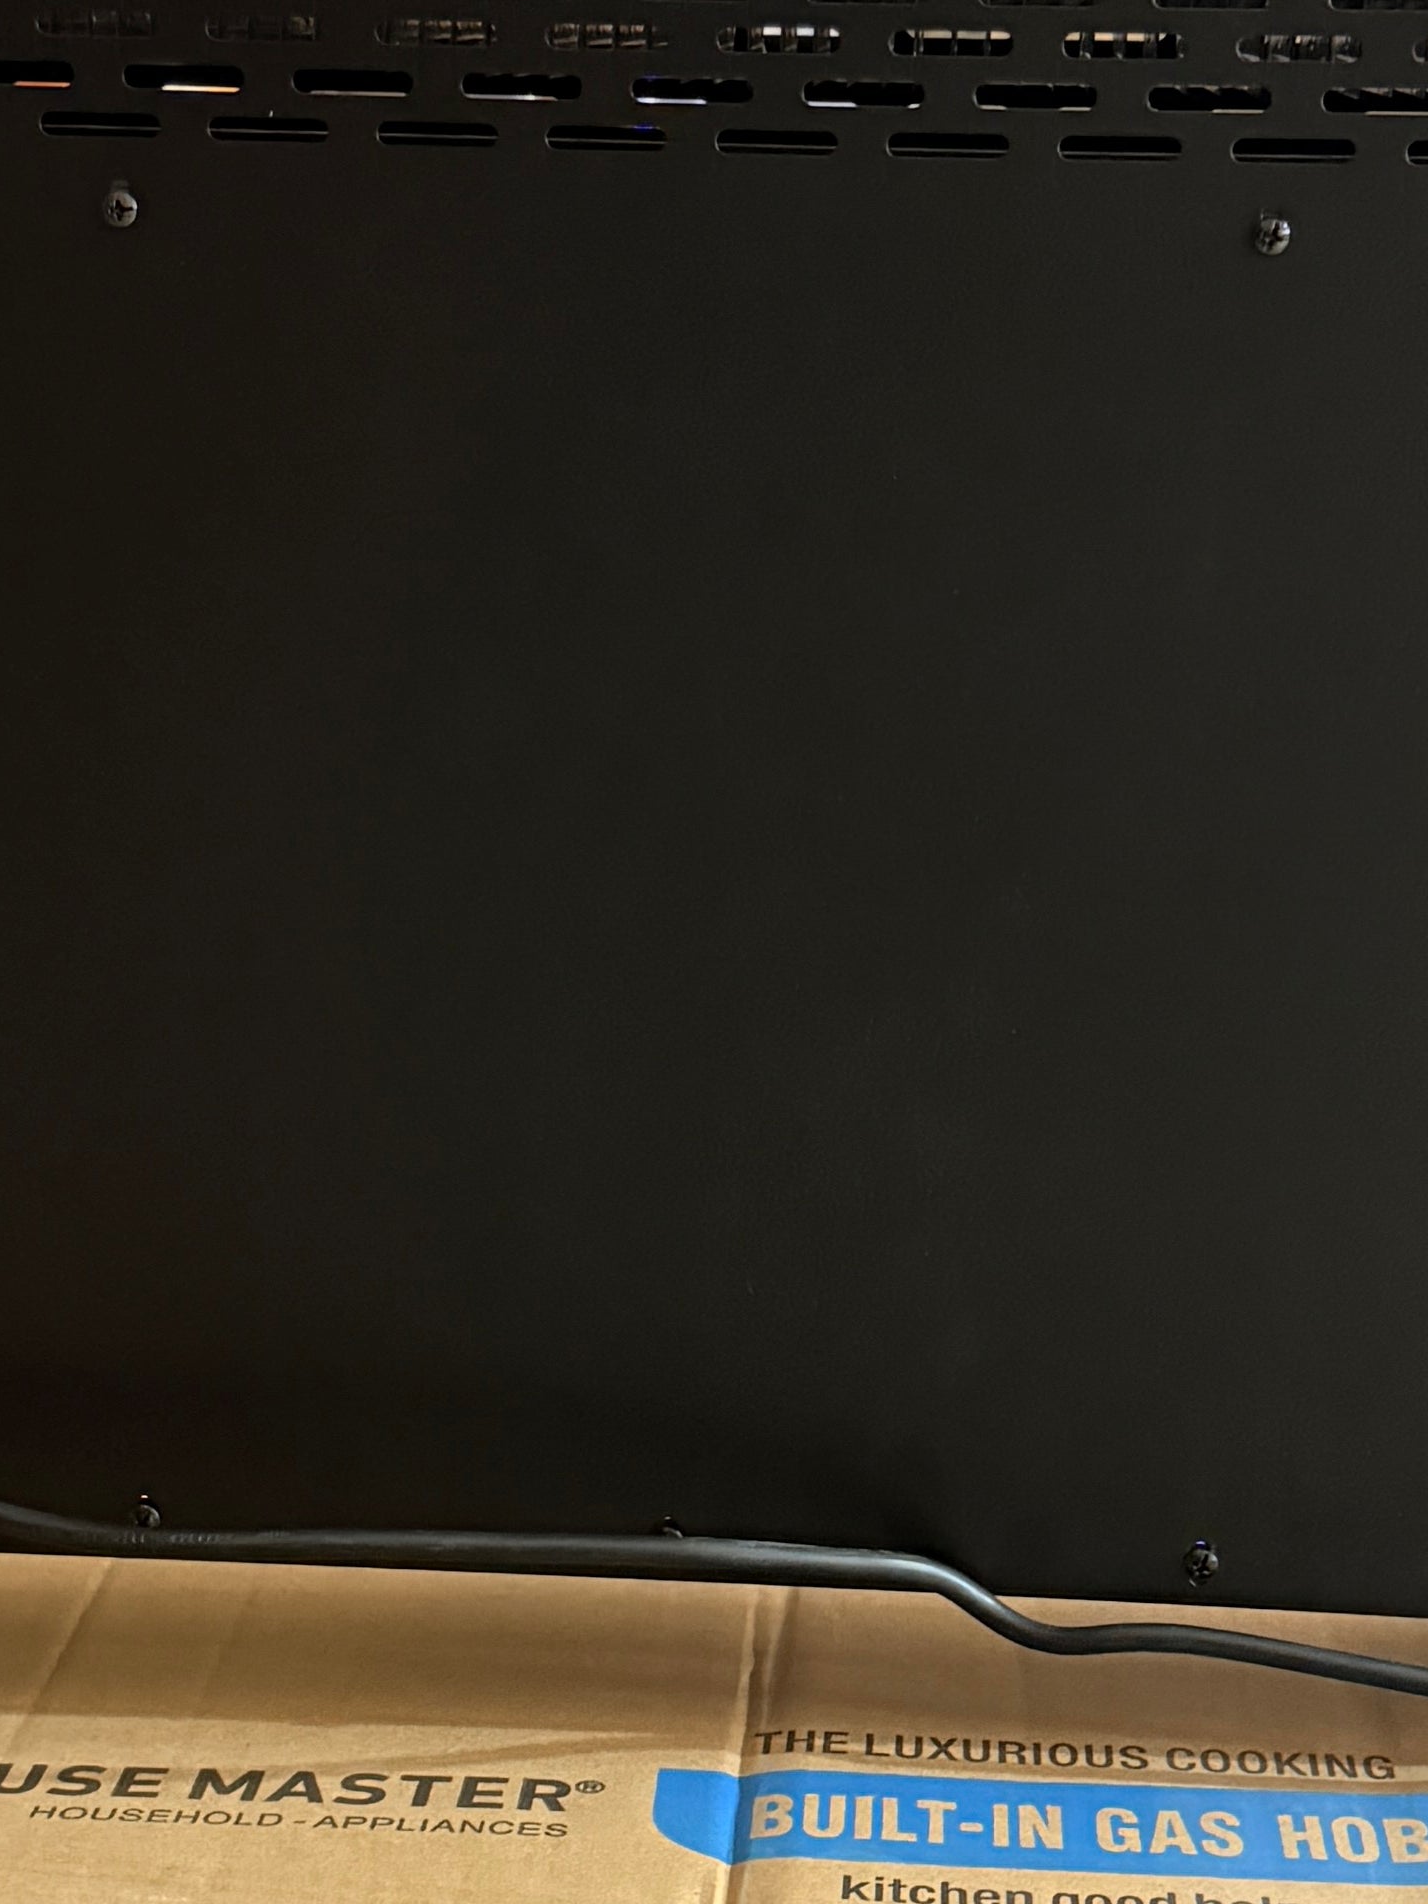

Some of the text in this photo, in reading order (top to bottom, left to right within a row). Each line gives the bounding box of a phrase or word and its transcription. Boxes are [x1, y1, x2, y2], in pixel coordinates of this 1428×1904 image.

[755, 1729, 1397, 1782] THE LUXURIOUS COOKING
[28, 1804, 569, 1839] HOUSEHOLD APPLIANCES
[746, 1791, 1066, 1852] BUILT-IN
[1095, 1804, 1246, 1860] GAS
